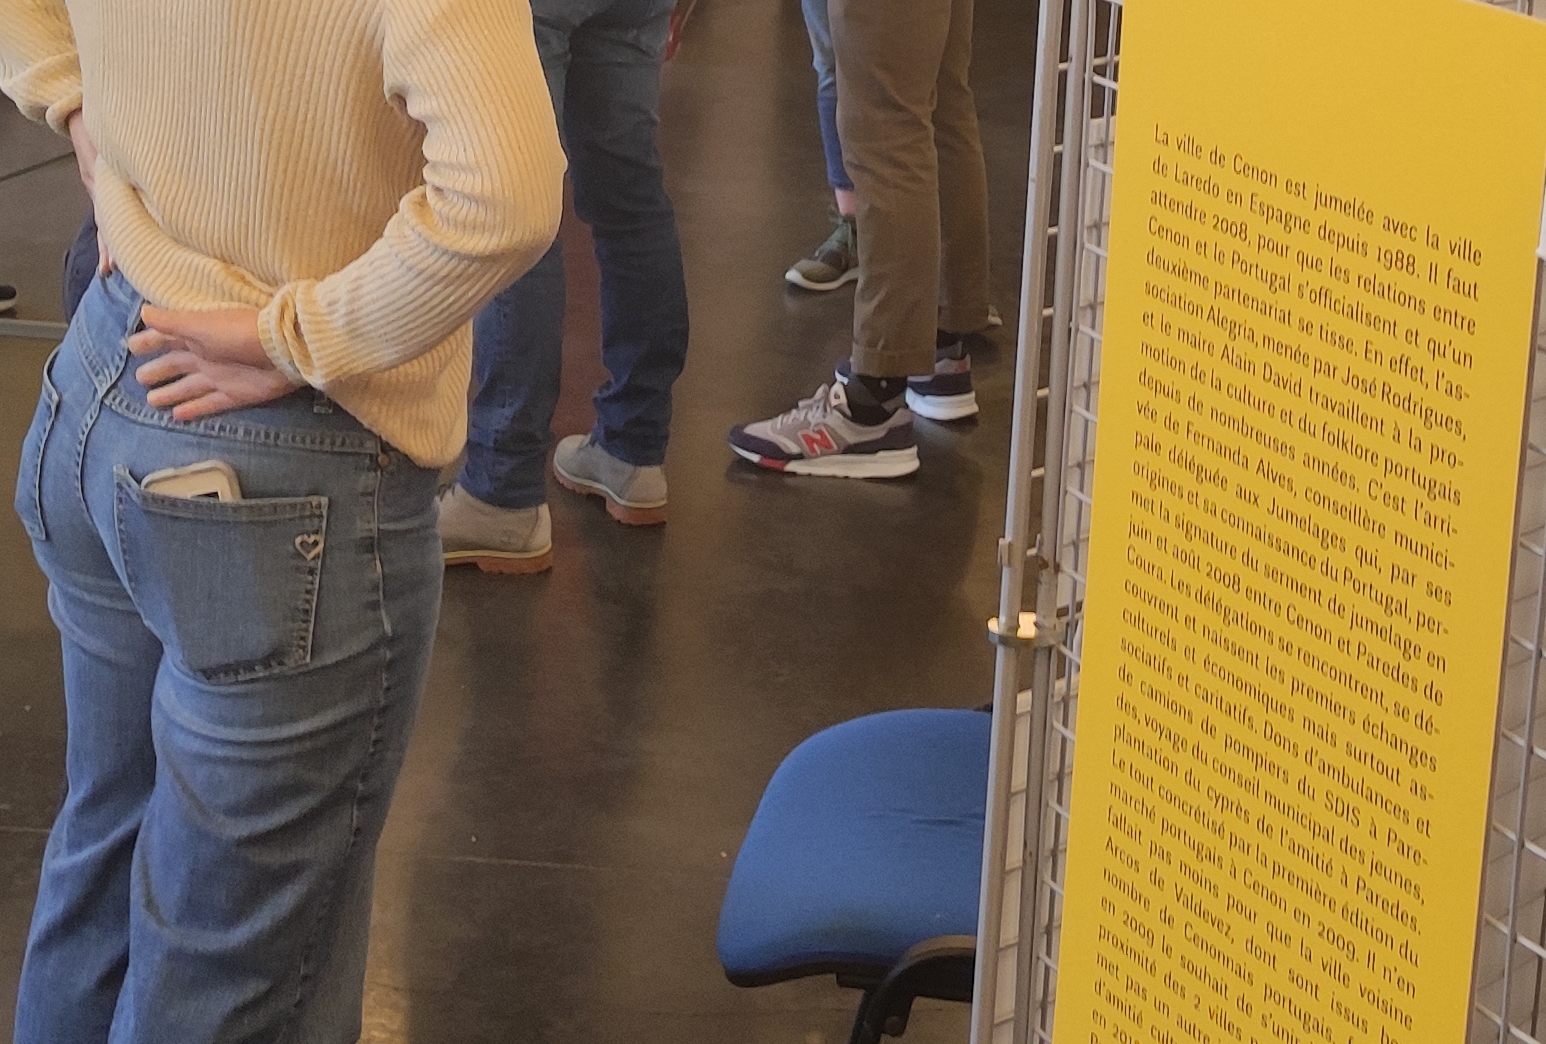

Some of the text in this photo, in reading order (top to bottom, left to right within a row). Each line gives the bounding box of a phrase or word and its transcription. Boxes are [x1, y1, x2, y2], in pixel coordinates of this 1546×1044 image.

[1149, 189, 1476, 336] attendre 2008, pour que les relations entre
[1151, 154, 1478, 302] de Laredo en Espagne depuis 1988. Il faut
[1154, 122, 1482, 266] La ville de Cenon est jumelée avec la ville
[1144, 281, 1466, 442] sociation Alegria, menée par José Rodrigues,
[1145, 245, 1470, 401] deuxième partenariat se tisse. En effet, l'as-
[1148, 215, 1473, 370] Cenon et le Portugal s'officialisent et qu'un
[1138, 366, 1457, 537] depuis de nombreuses années. C'est l'arri-
[1140, 341, 1461, 506] motion de la culture et du folklore portugais
[1141, 311, 1463, 469] et le maire Alain David travaillent à la pro-
[1120, 637, 1431, 839] sociatifs et caritatifs. Dons d'ambulances et
[1123, 578, 1437, 772] couvrent et naissent les premiers échanges
[1107, 804, 1413, 1031] fallait pas moins pour que la ville voisine
